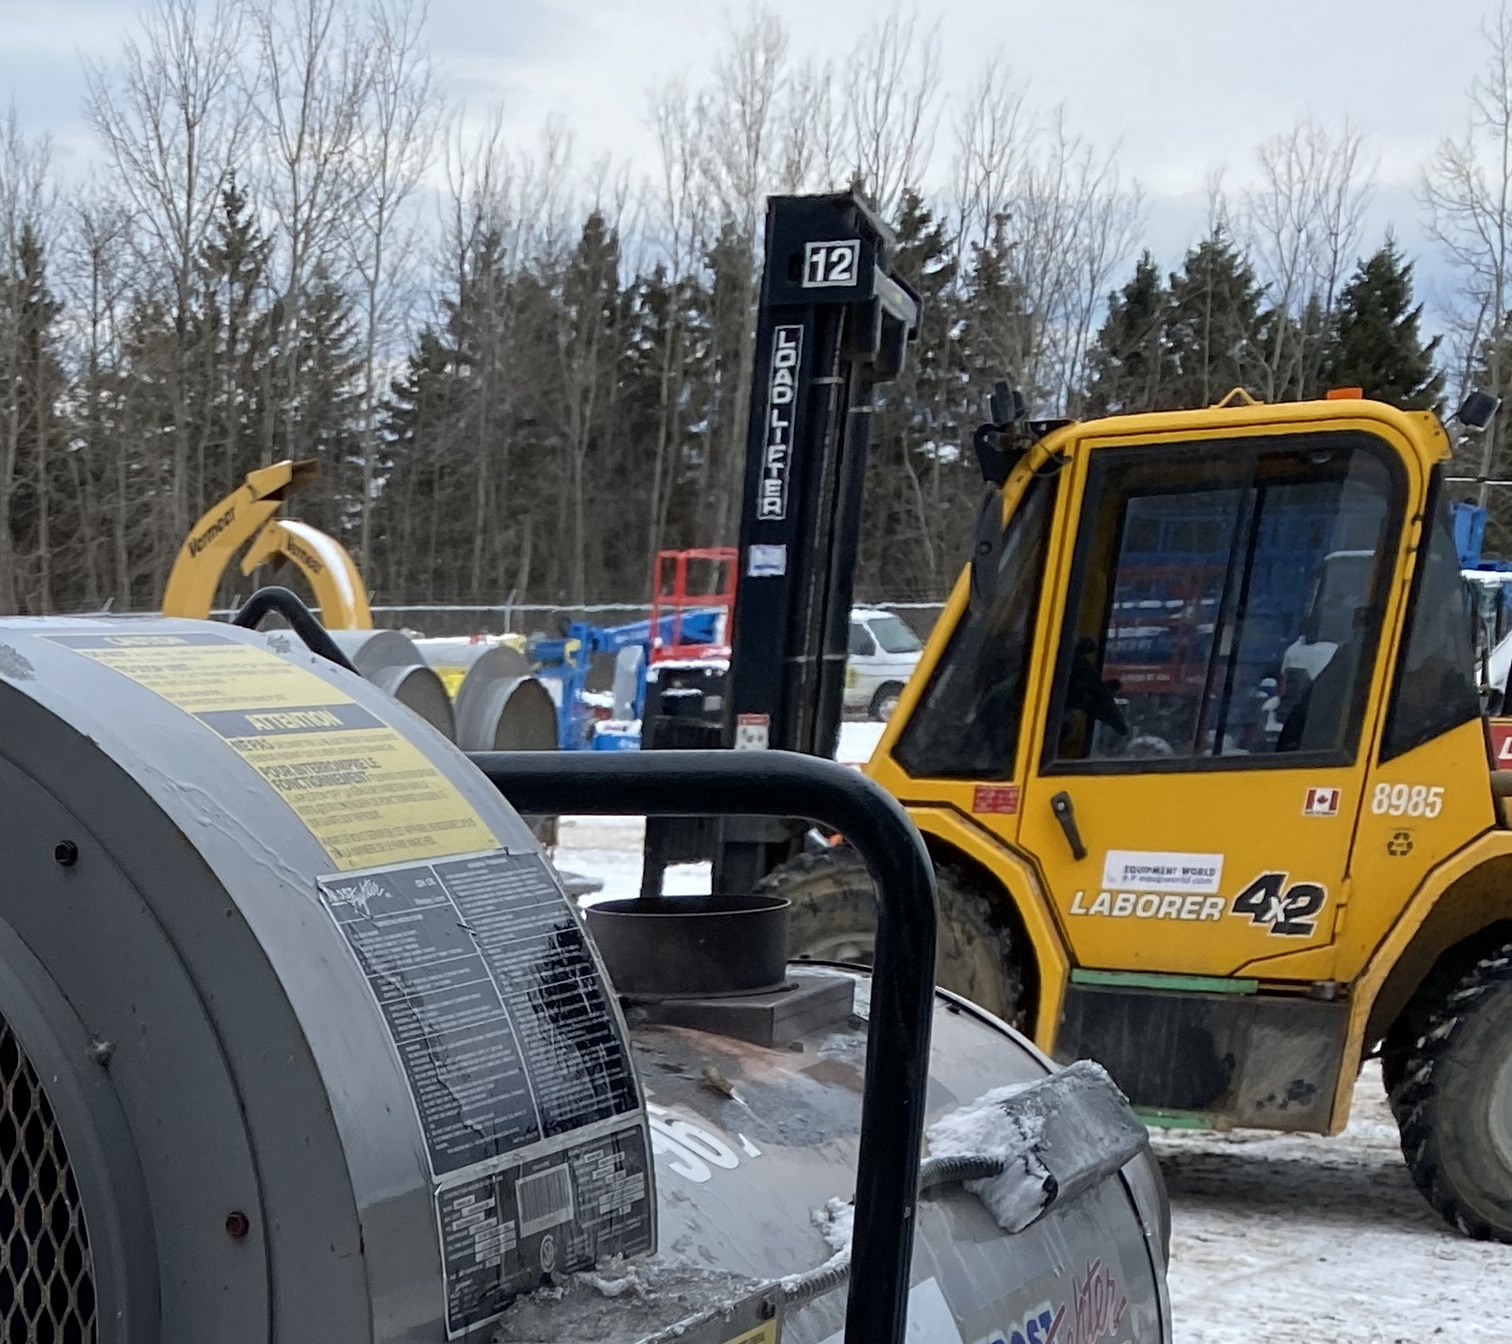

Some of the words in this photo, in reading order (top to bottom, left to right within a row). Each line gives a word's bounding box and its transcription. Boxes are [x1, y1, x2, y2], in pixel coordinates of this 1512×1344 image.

[810, 247, 853, 282] 12
[188, 507, 235, 559] Vermeer
[245, 709, 344, 730] ATTENTION
[1371, 783, 1444, 818] 8985
[1182, 866, 1216, 877] WORLD
[1070, 892, 1226, 921] LABORER
